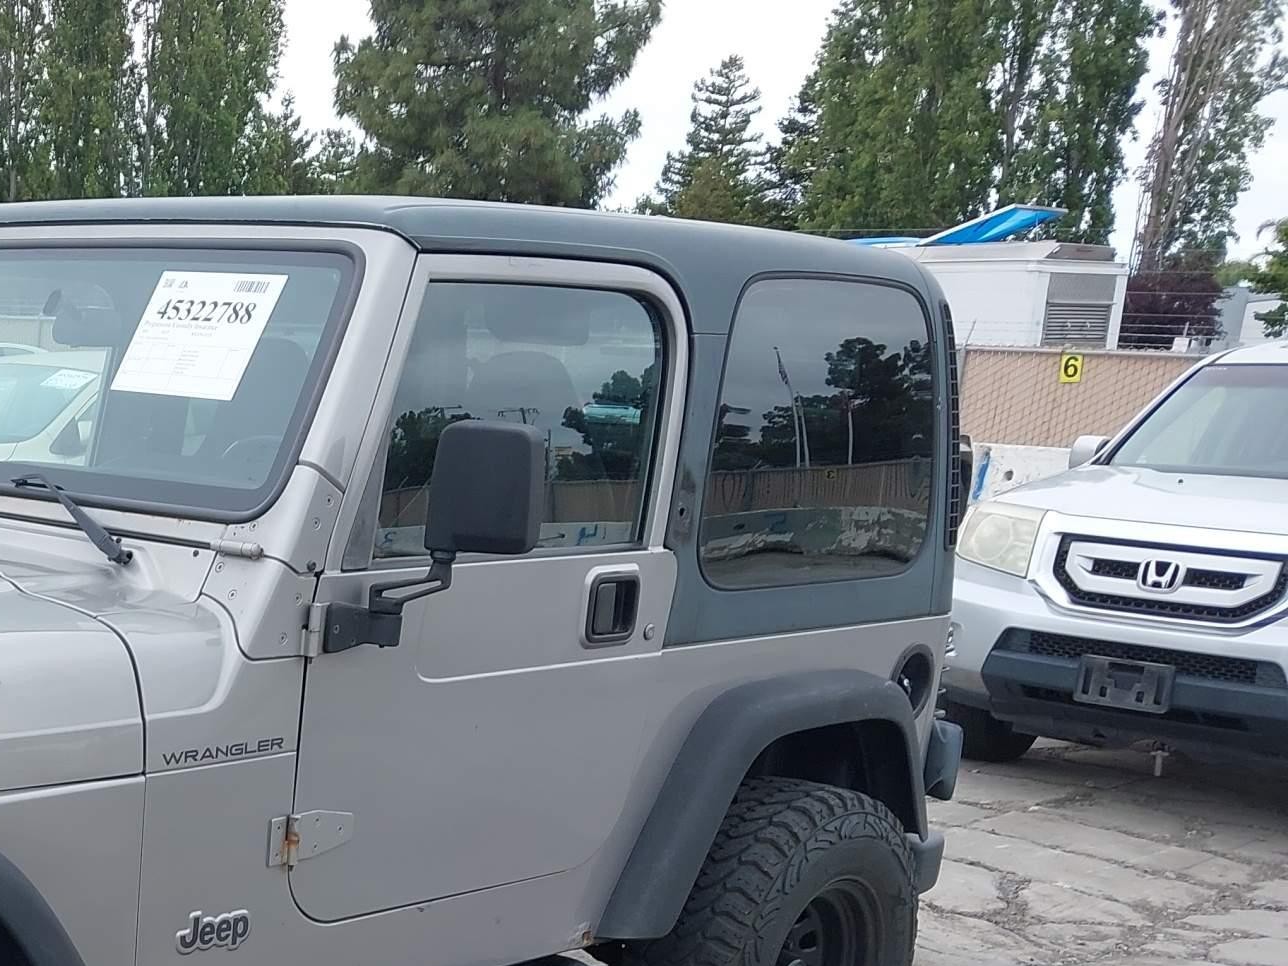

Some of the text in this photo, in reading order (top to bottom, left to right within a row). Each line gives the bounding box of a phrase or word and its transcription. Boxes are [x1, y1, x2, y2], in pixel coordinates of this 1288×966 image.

[156, 298, 257, 325] 45322788
[1064, 356, 1079, 378] 6
[162, 737, 284, 766] WRANGLER
[176, 909, 250, 955] Jeep
